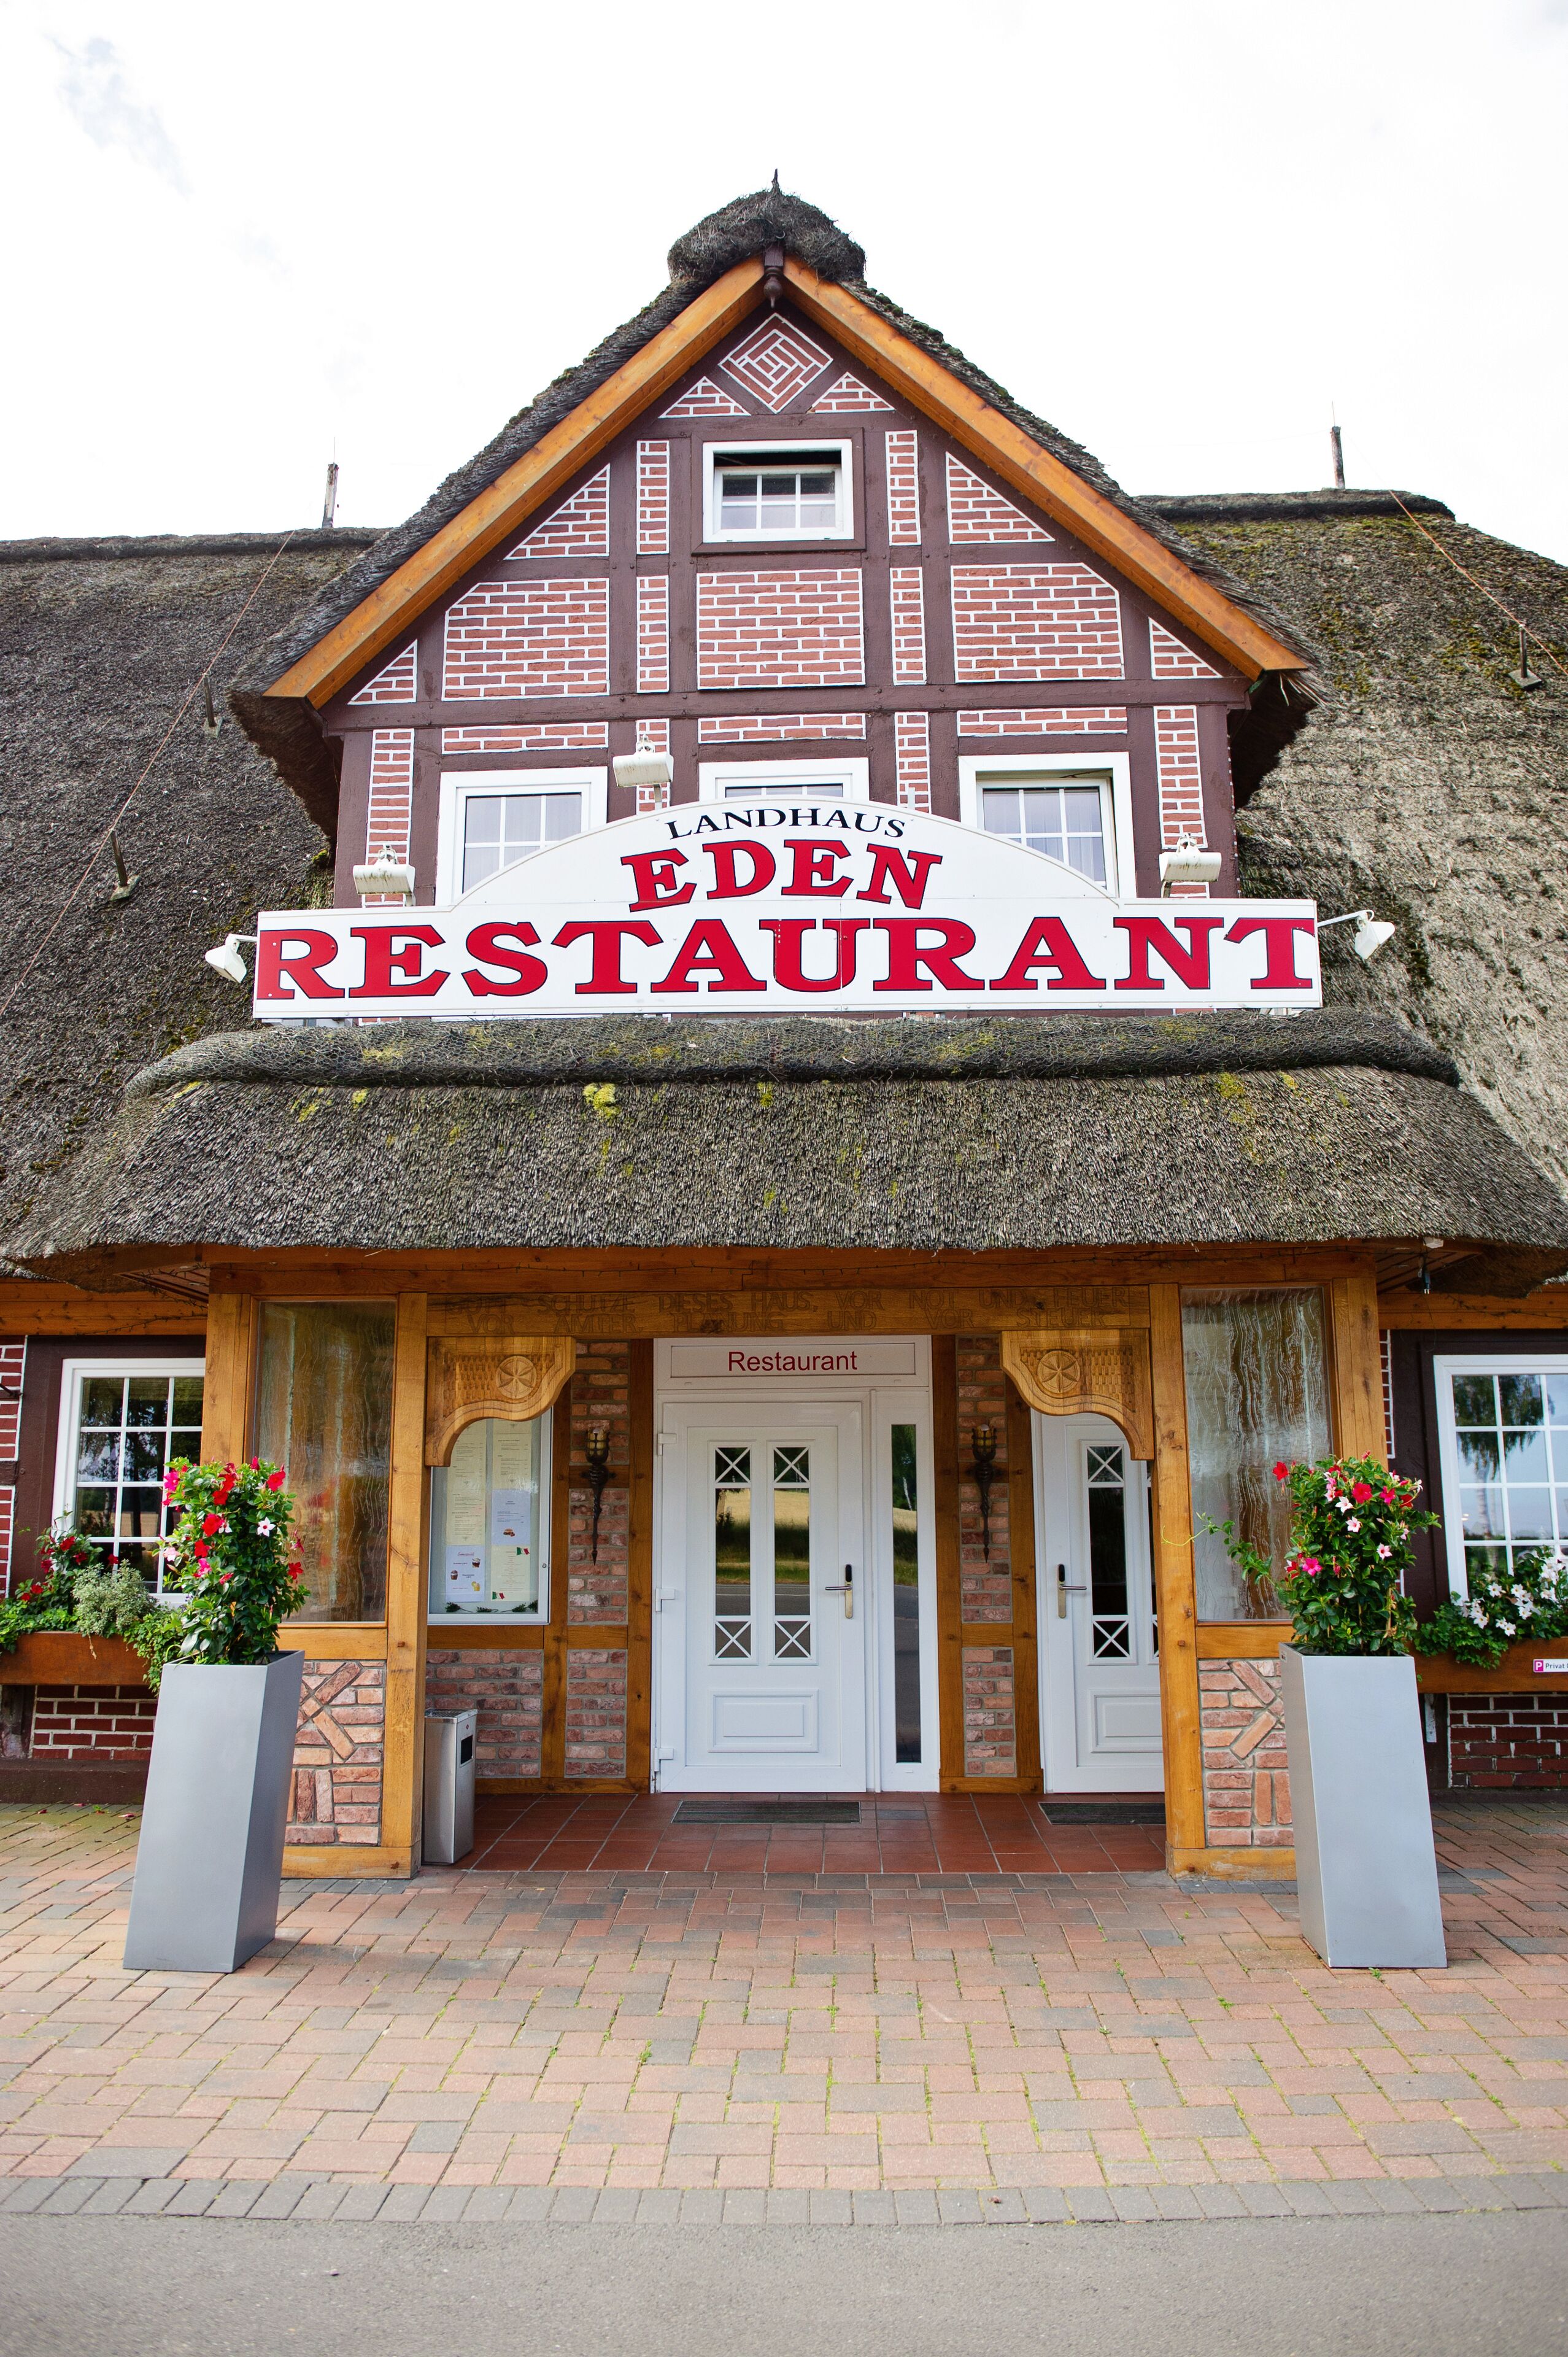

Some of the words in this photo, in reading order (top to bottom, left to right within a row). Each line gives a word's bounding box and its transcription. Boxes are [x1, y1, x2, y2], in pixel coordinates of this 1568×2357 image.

[666, 808, 905, 840] LANDHAUS
[619, 838, 944, 913] EDEN
[256, 916, 1316, 1000] RESTAURANT
[658, 1292, 734, 1312] DIESES
[834, 1290, 885, 1311] VOR
[909, 1289, 959, 1309] NOT
[979, 1288, 1027, 1309] UND
[1051, 1286, 1130, 1308] FEUER
[466, 1314, 516, 1334] VOR
[827, 1310, 878, 1331] UND
[922, 1308, 975, 1329] VOR
[1016, 1306, 1106, 1328] STEUER
[728, 1350, 857, 1372] Restaurant
[1535, 1662, 1543, 1671] P
